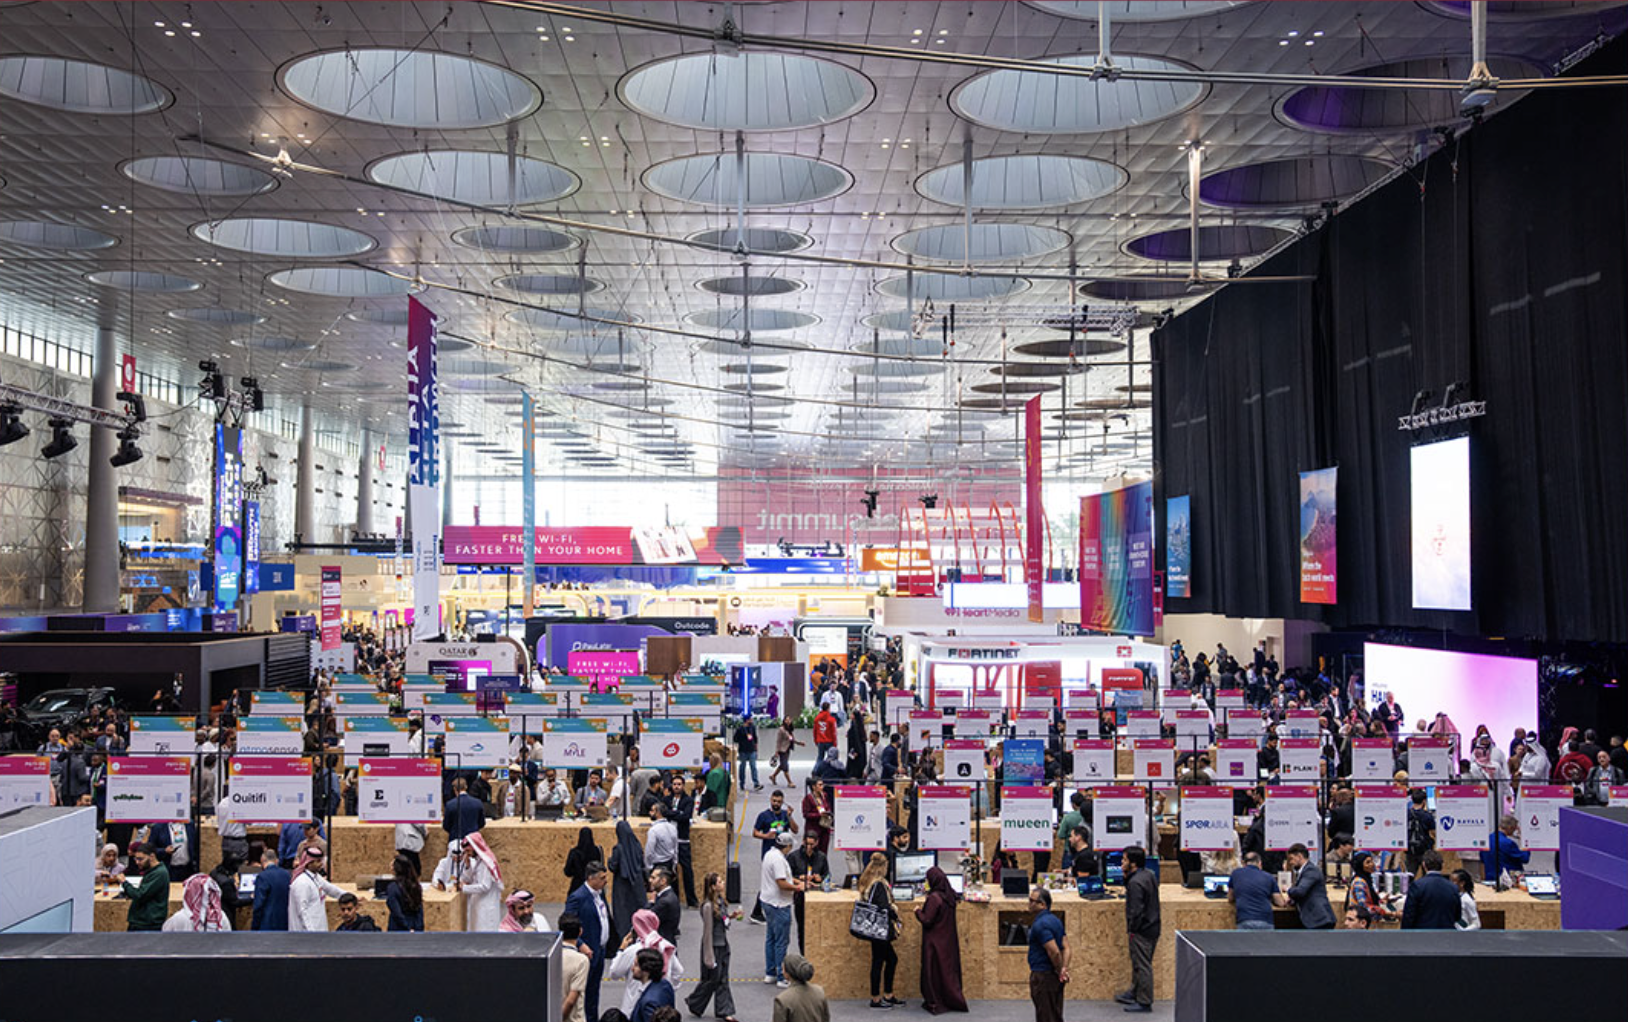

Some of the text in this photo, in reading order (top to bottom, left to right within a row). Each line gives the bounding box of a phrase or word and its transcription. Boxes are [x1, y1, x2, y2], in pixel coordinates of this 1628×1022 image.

[225, 451, 234, 526] PITCH
[502, 533, 577, 545] FRE WI-FI,
[455, 545, 623, 555] FASTER THN YOUR HOME
[439, 647, 467, 655] QATAR
[948, 648, 1021, 659] FORTINET
[232, 793, 267, 804] Quitifi
[1004, 819, 1050, 829] mueen
